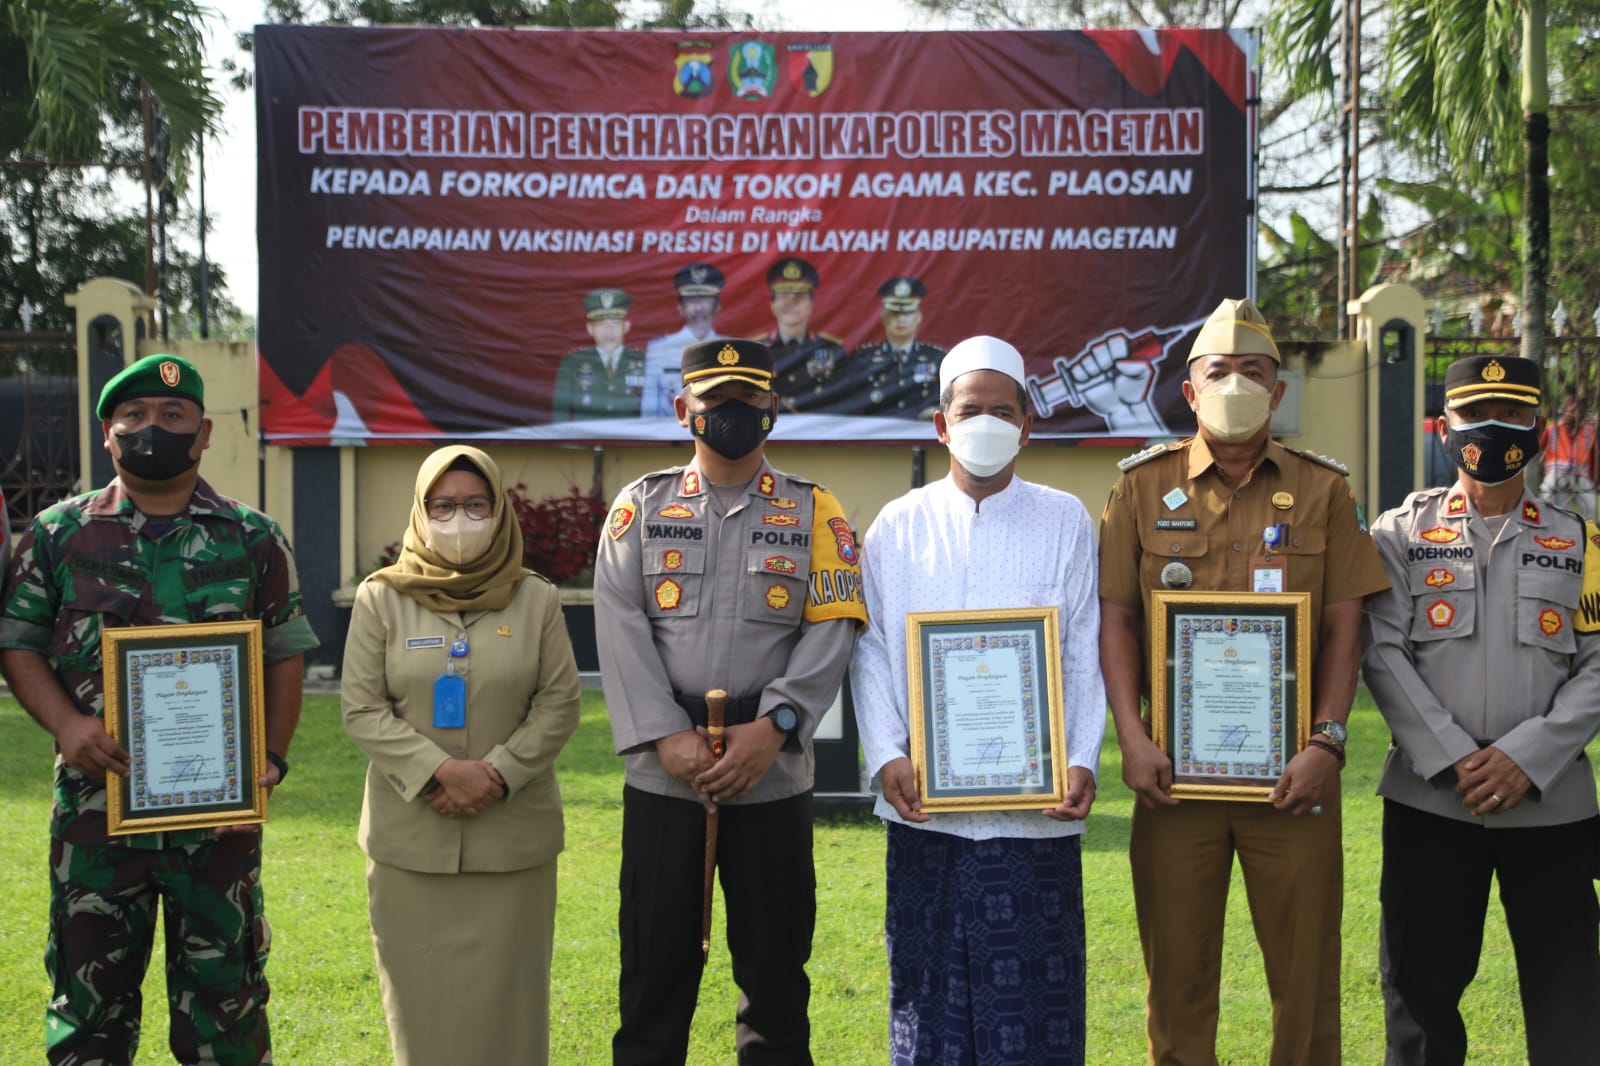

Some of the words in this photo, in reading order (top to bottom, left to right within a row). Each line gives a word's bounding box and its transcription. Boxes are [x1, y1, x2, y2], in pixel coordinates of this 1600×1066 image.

[298, 107, 525, 158] PEMBERIAN
[530, 113, 814, 162] PENGHARGAAN
[819, 110, 1016, 160] KAPOLRES
[1020, 108, 1204, 157] MAGETAN
[310, 168, 431, 195] KEPADA
[440, 171, 647, 199] FORKOPIMCA
[655, 173, 722, 199] DAN
[733, 173, 842, 200] TOKOH
[849, 171, 965, 198] AGAMA
[974, 170, 1037, 196] KEC.
[1048, 169, 1193, 196] PLAOSAN
[685, 205, 746, 223] Dalam
[750, 205, 822, 227] Rangka
[326, 226, 492, 251] PENCAPAIAN
[498, 229, 634, 253] VAKSINASI
[642, 230, 734, 253] PRESISI
[741, 231, 769, 253] DI
[776, 229, 889, 252] WILAYAH
[896, 228, 1045, 251] KABUPATEN
[1050, 227, 1177, 250] MAGETAN
[646, 524, 704, 541] YAKHOB
[751, 531, 809, 548] POLRI
[1522, 553, 1583, 575] POLRI
